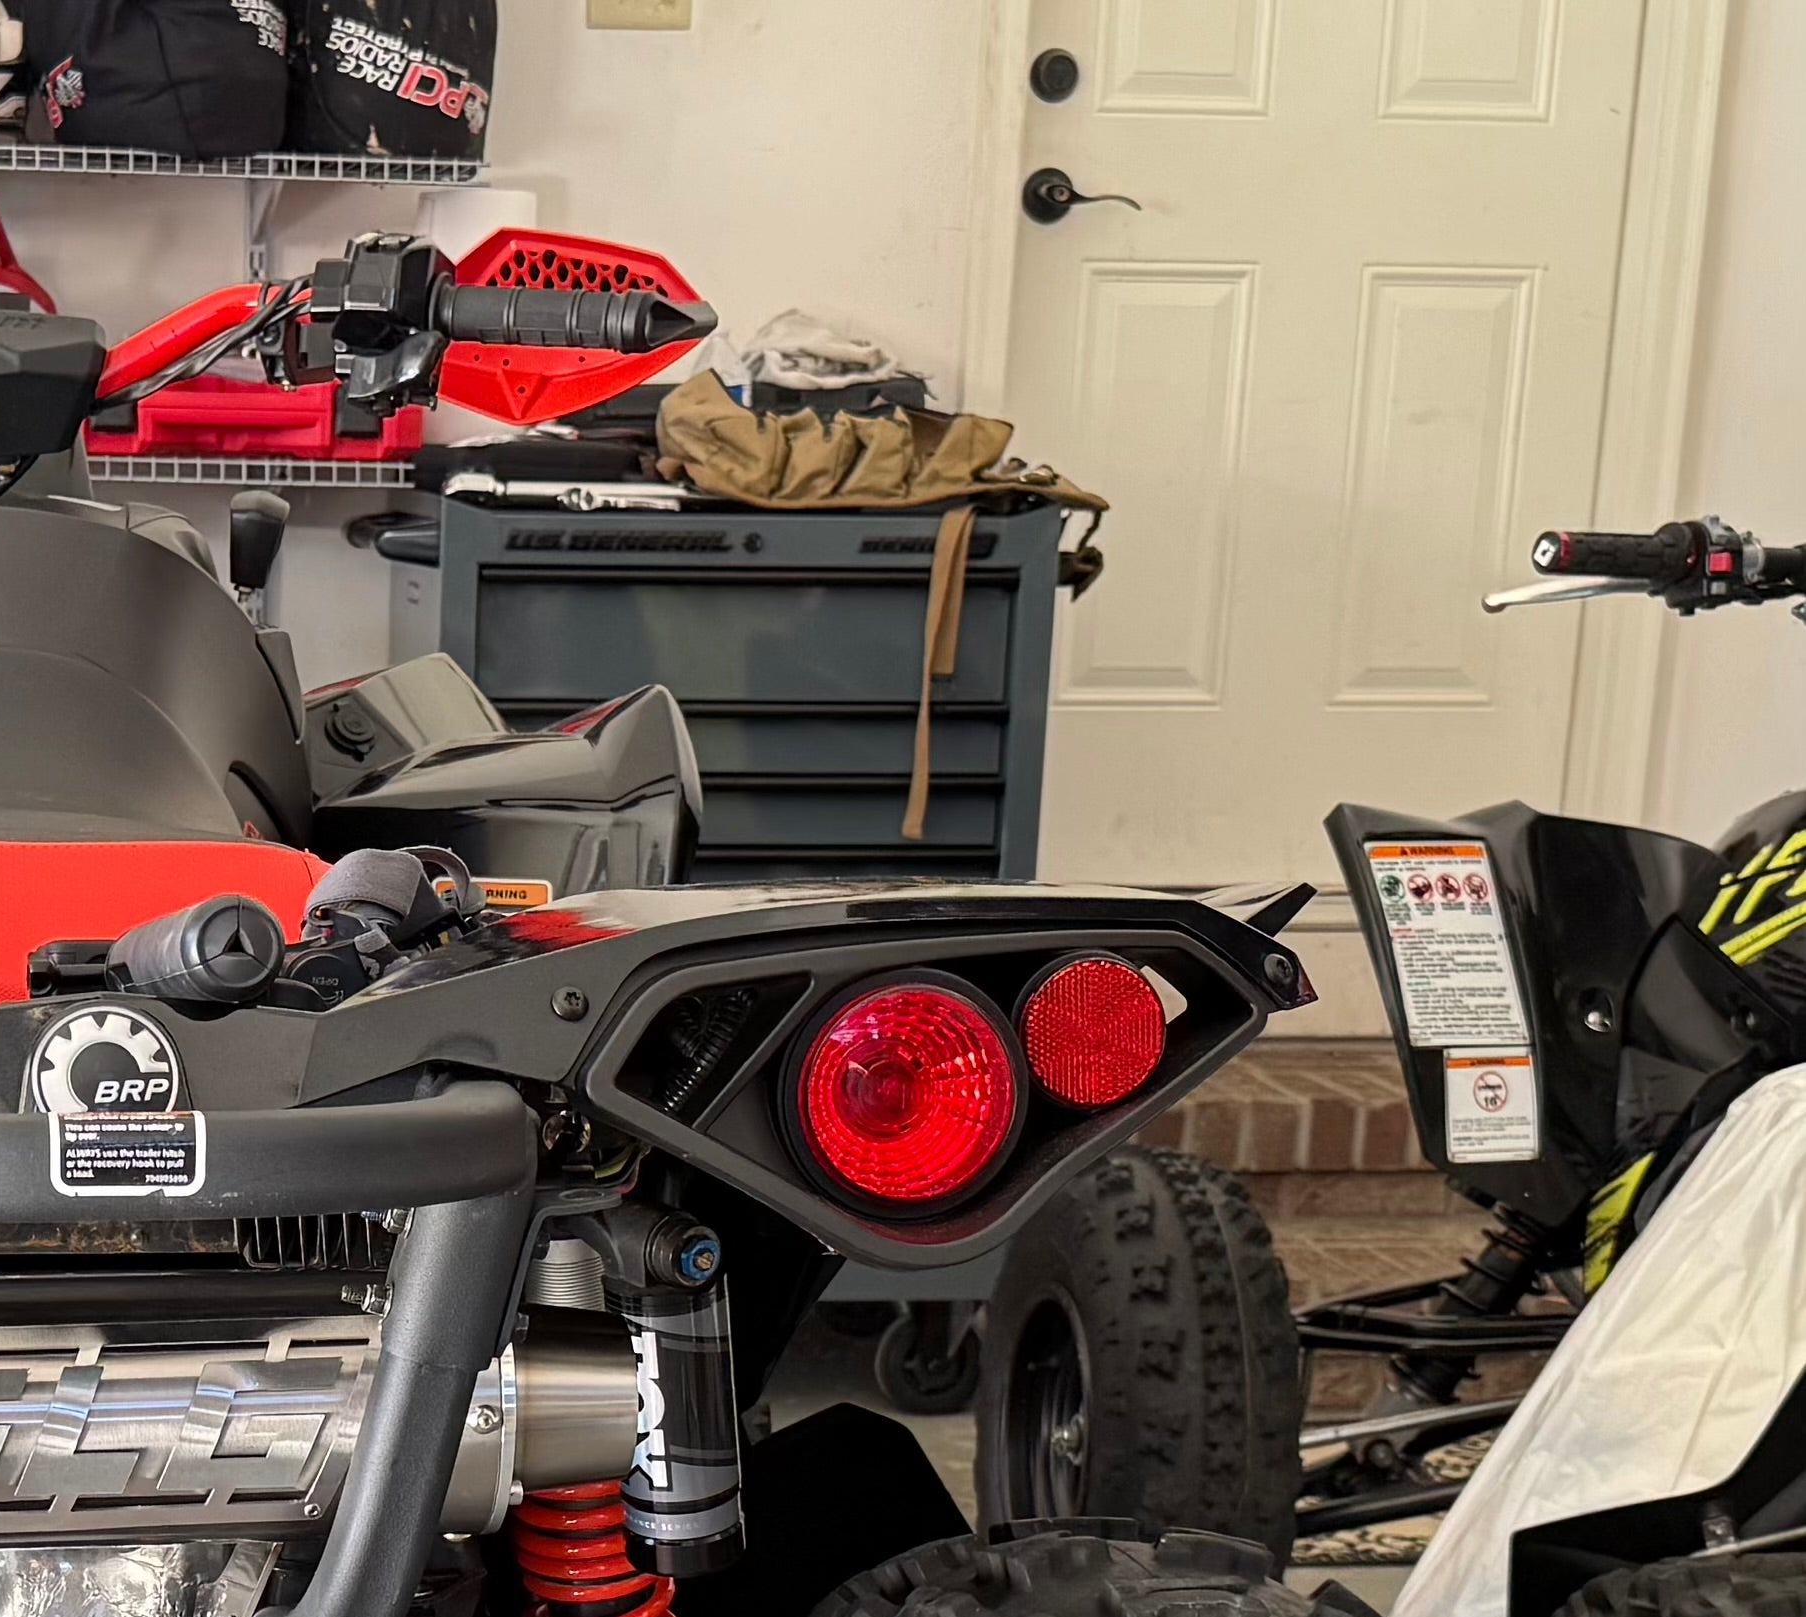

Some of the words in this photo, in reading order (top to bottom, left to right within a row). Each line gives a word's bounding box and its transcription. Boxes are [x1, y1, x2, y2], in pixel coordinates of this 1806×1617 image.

[325, 31, 408, 74] RADIOS
[336, 54, 400, 92] RACE
[397, 62, 470, 119] PCI
[486, 888, 528, 900] RNING
[94, 1078, 170, 1104] BRP
[128, 1123, 142, 1131] the
[66, 1149, 101, 1158] ALWAYS
[103, 1150, 118, 1158] use
[120, 1149, 134, 1158] the
[136, 1149, 161, 1158] trailer
[66, 1160, 75, 1168] or
[77, 1159, 92, 1168] the
[93, 1160, 130, 1170] recovery
[132, 1159, 155, 1168] hook
[156, 1160, 165, 1168] to
[166, 1159, 184, 1169] pull
